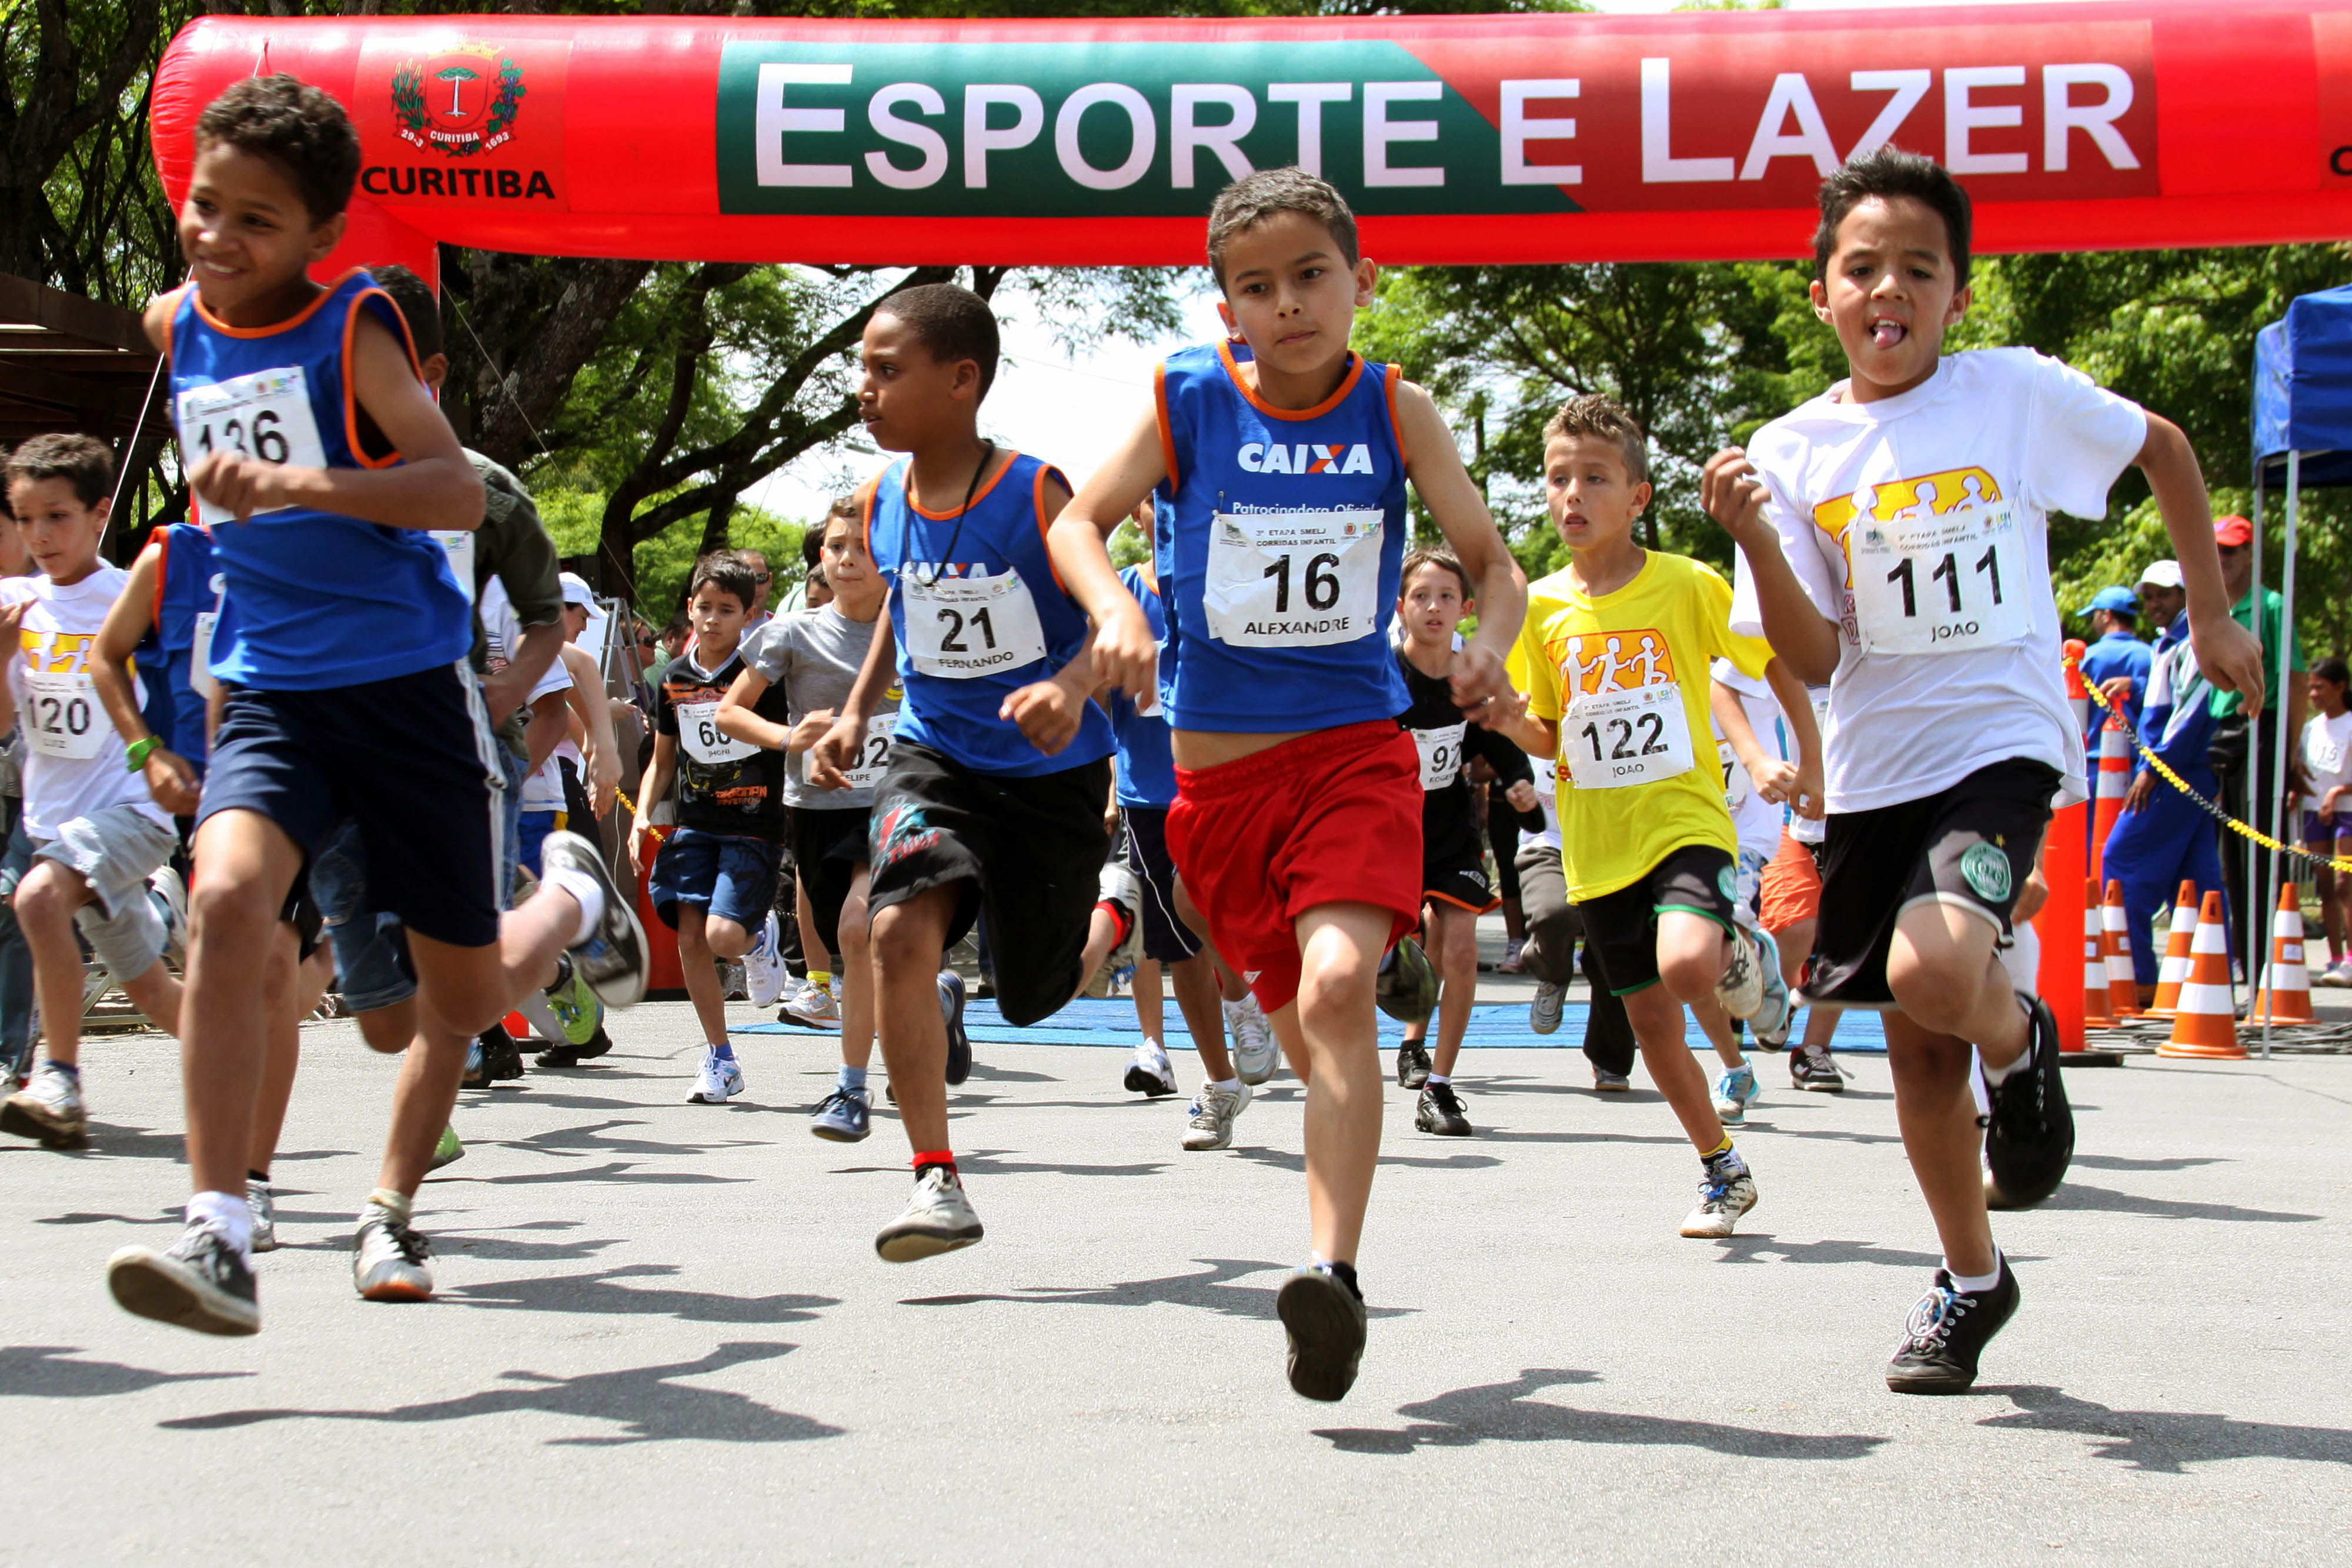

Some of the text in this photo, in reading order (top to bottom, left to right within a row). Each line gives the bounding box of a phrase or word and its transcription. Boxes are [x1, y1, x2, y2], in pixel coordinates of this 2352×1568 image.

[756, 57, 2140, 189] ESPORTE E LAZER
[400, 129, 510, 151] 29-3 CURITIBA 1693
[360, 166, 556, 199] CURITIBA
[1237, 443, 1374, 475] CAIXA
[1232, 502, 1329, 514] Patrocinadora
[1264, 553, 1340, 613] 16
[1886, 544, 2003, 617] 111
[937, 606, 997, 653] 21
[1244, 616, 1350, 636] ALEXANDRE
[1930, 620, 1979, 643] JOAO
[938, 650, 1014, 669] FERNANDO
[29, 696, 90, 735] 120
[1582, 712, 1669, 762] 122
[846, 773, 871, 781] ELIPE
[1612, 763, 1645, 778] JOAO
